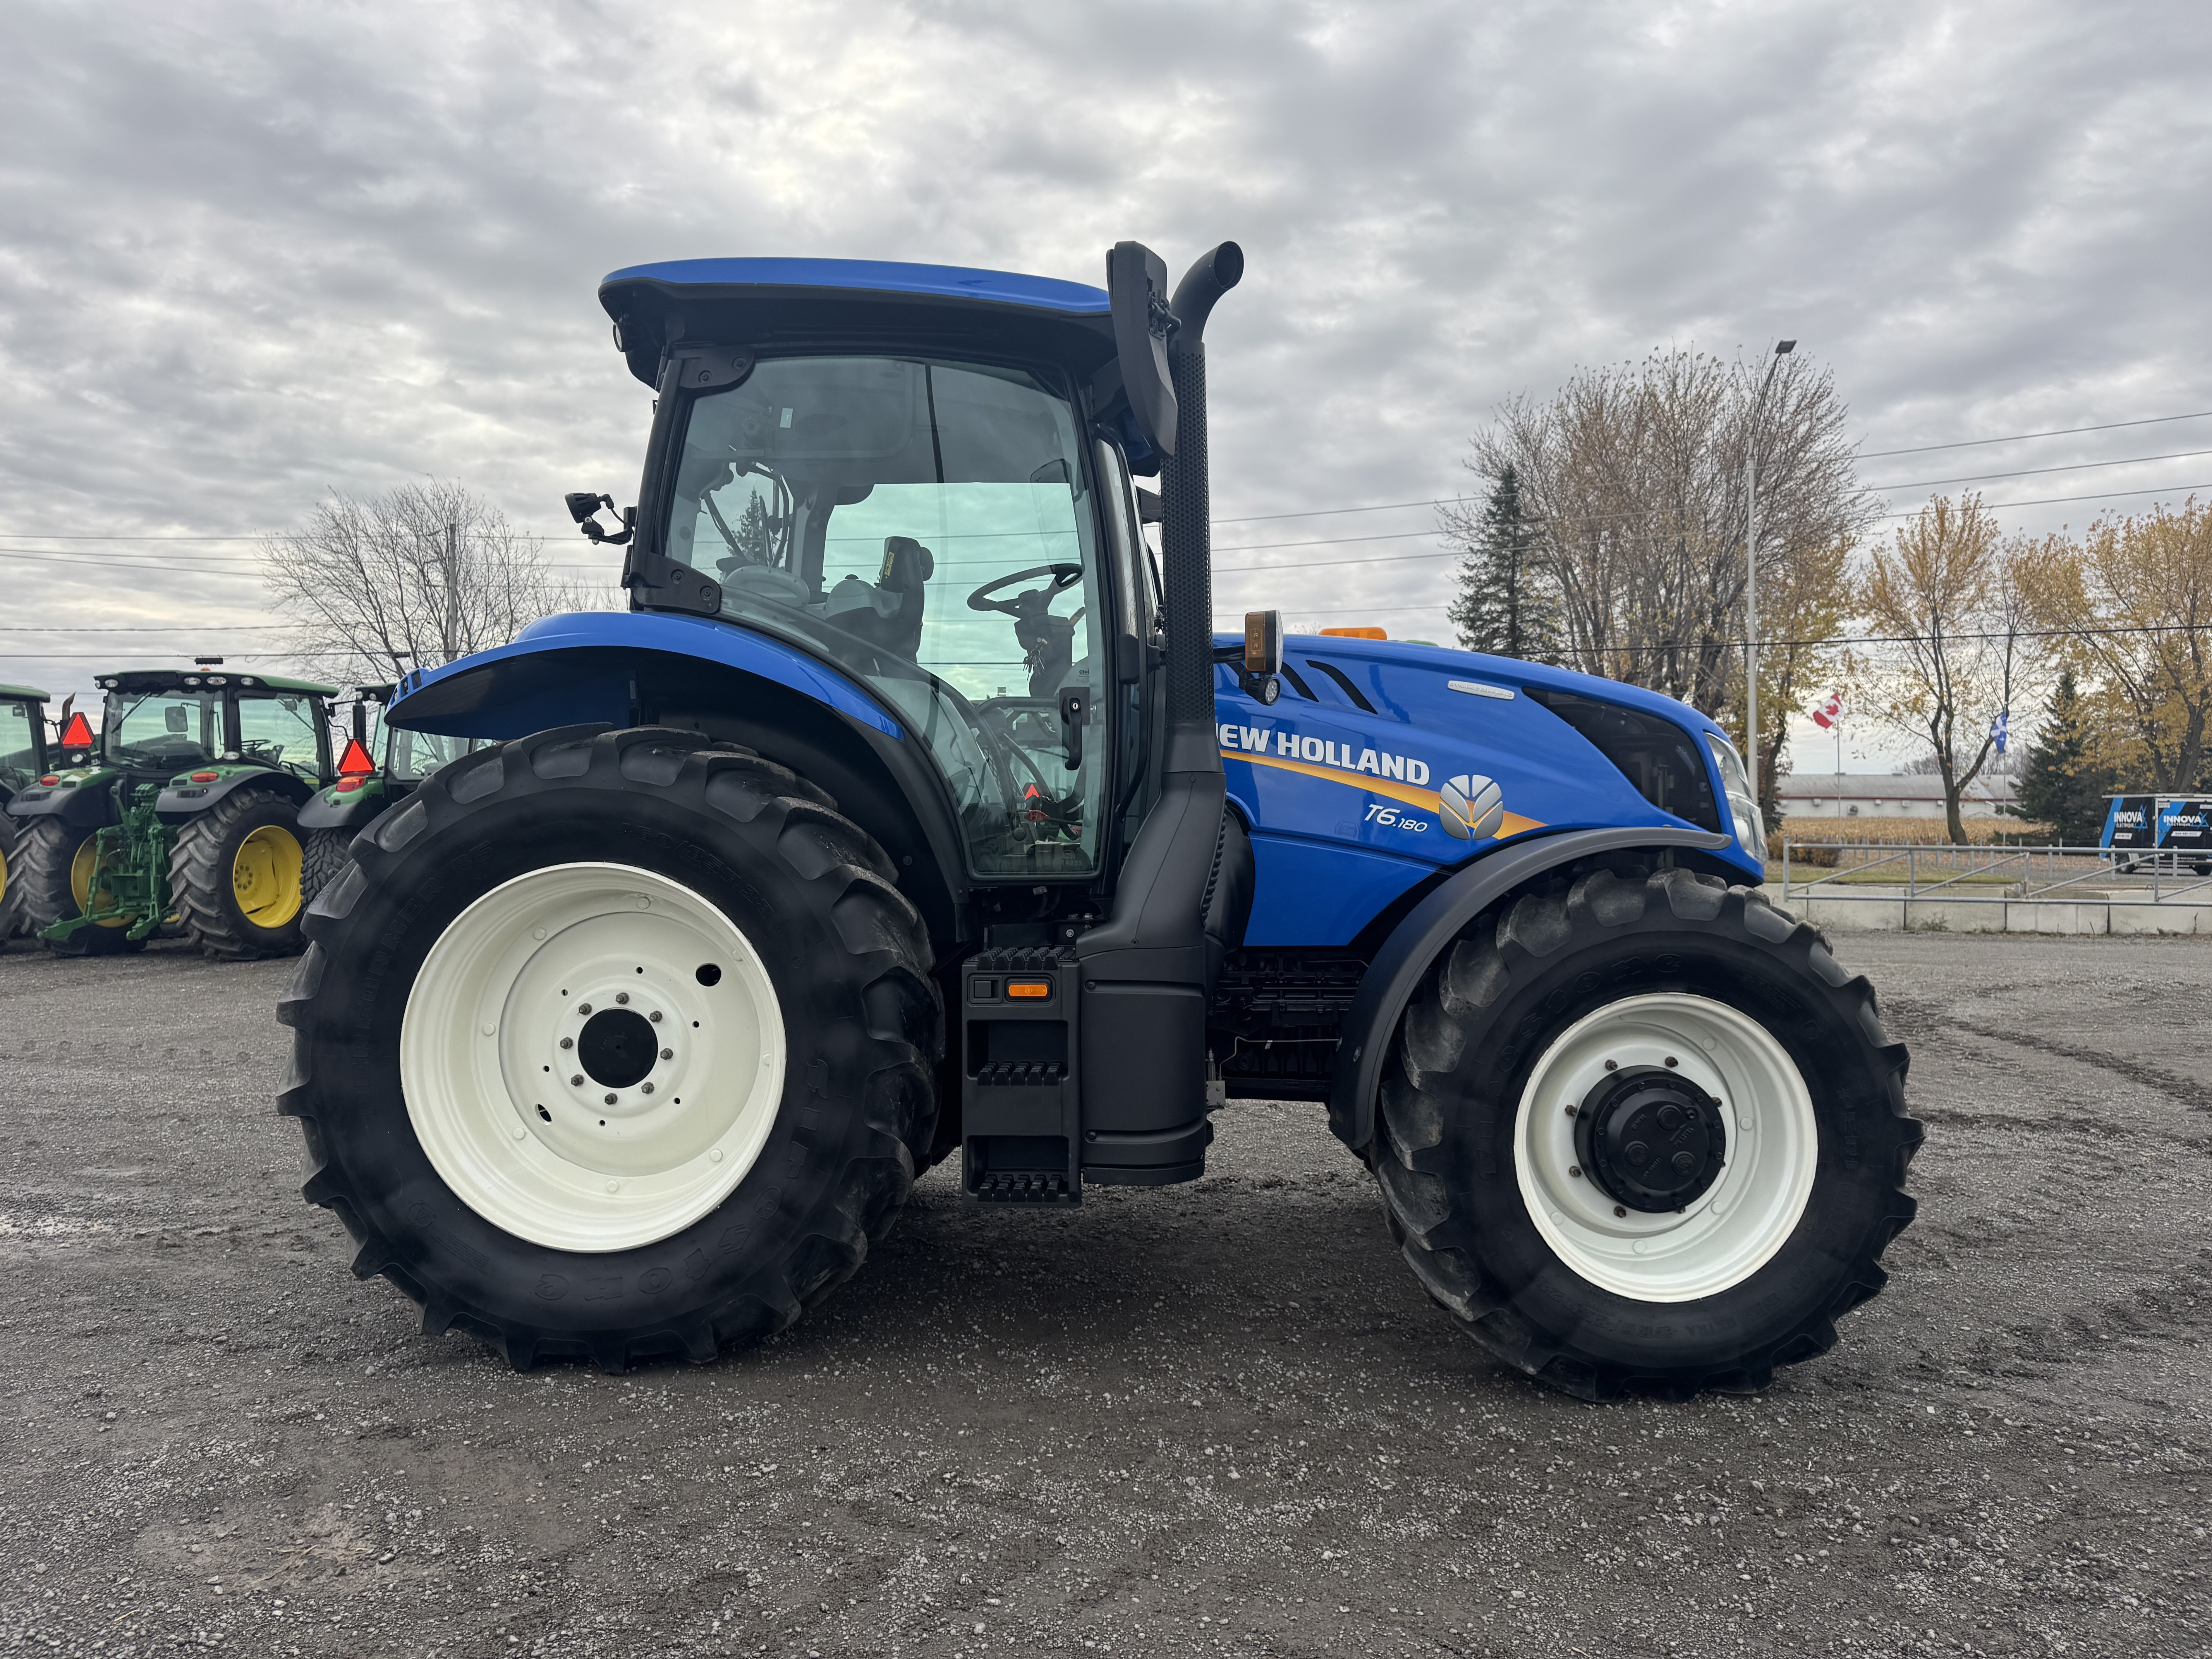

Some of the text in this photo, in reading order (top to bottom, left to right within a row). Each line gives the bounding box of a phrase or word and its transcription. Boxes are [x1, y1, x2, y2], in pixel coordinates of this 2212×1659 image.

[1278, 732, 1429, 785] HOLLAND
[1364, 804, 1428, 832] T6.180
[2114, 811, 2143, 823] INNOVA
[2163, 815, 2202, 823] INNOVA
